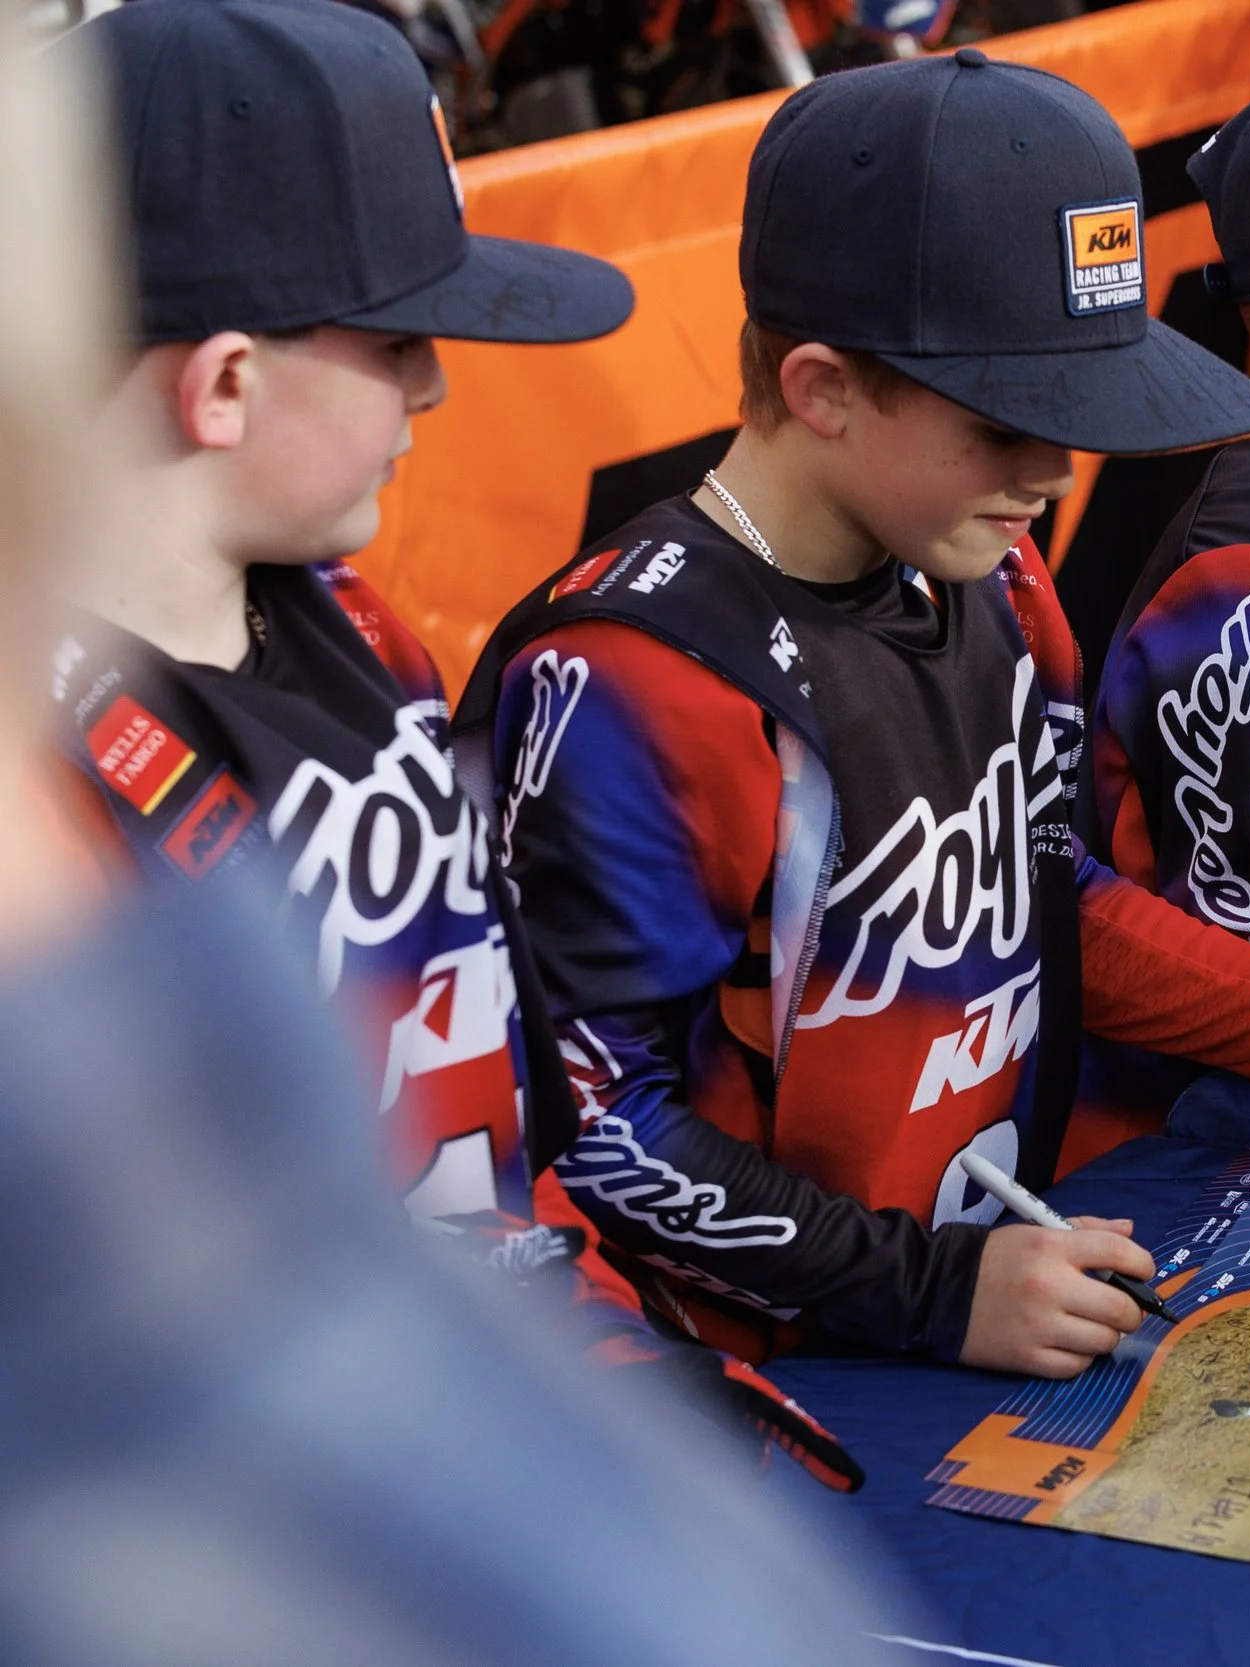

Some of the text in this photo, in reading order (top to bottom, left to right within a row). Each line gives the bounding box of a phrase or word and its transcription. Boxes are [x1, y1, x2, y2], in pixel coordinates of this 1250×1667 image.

[1087, 223, 1131, 253] KTM
[1076, 260, 1139, 288] RACING TEAM
[1078, 295, 1093, 310] JR.
[591, 540, 652, 597] Presented by
[628, 541, 687, 595] KTM
[98, 714, 151, 773] WELLS
[114, 728, 168, 787] FARGO
[1034, 1455, 1086, 1491] KTM
